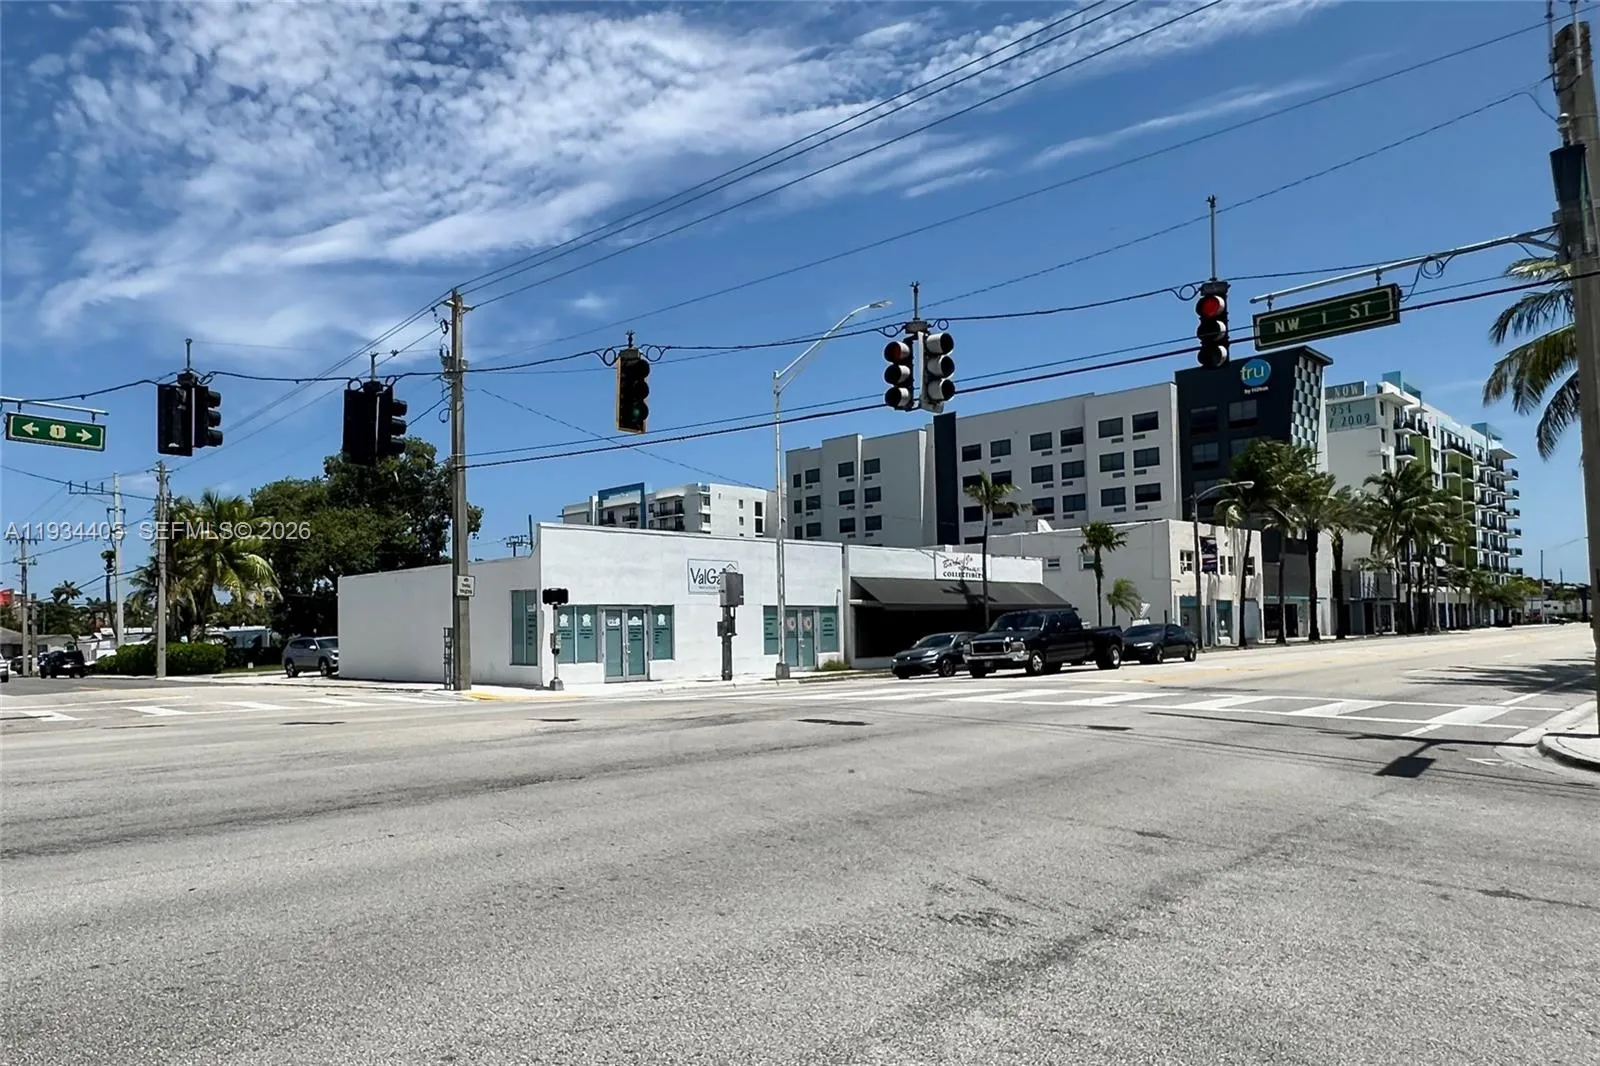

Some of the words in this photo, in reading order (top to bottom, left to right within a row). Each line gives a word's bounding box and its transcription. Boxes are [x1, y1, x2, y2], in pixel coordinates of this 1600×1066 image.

[1275, 316, 1300, 333] NW
[1321, 310, 1327, 325] 1
[1350, 301, 1371, 319] ST
[1240, 365, 1265, 381] tru
[1334, 384, 1359, 398] NOW
[690, 567, 721, 585] ValGa
[943, 571, 983, 579] COLLECTIBLE
